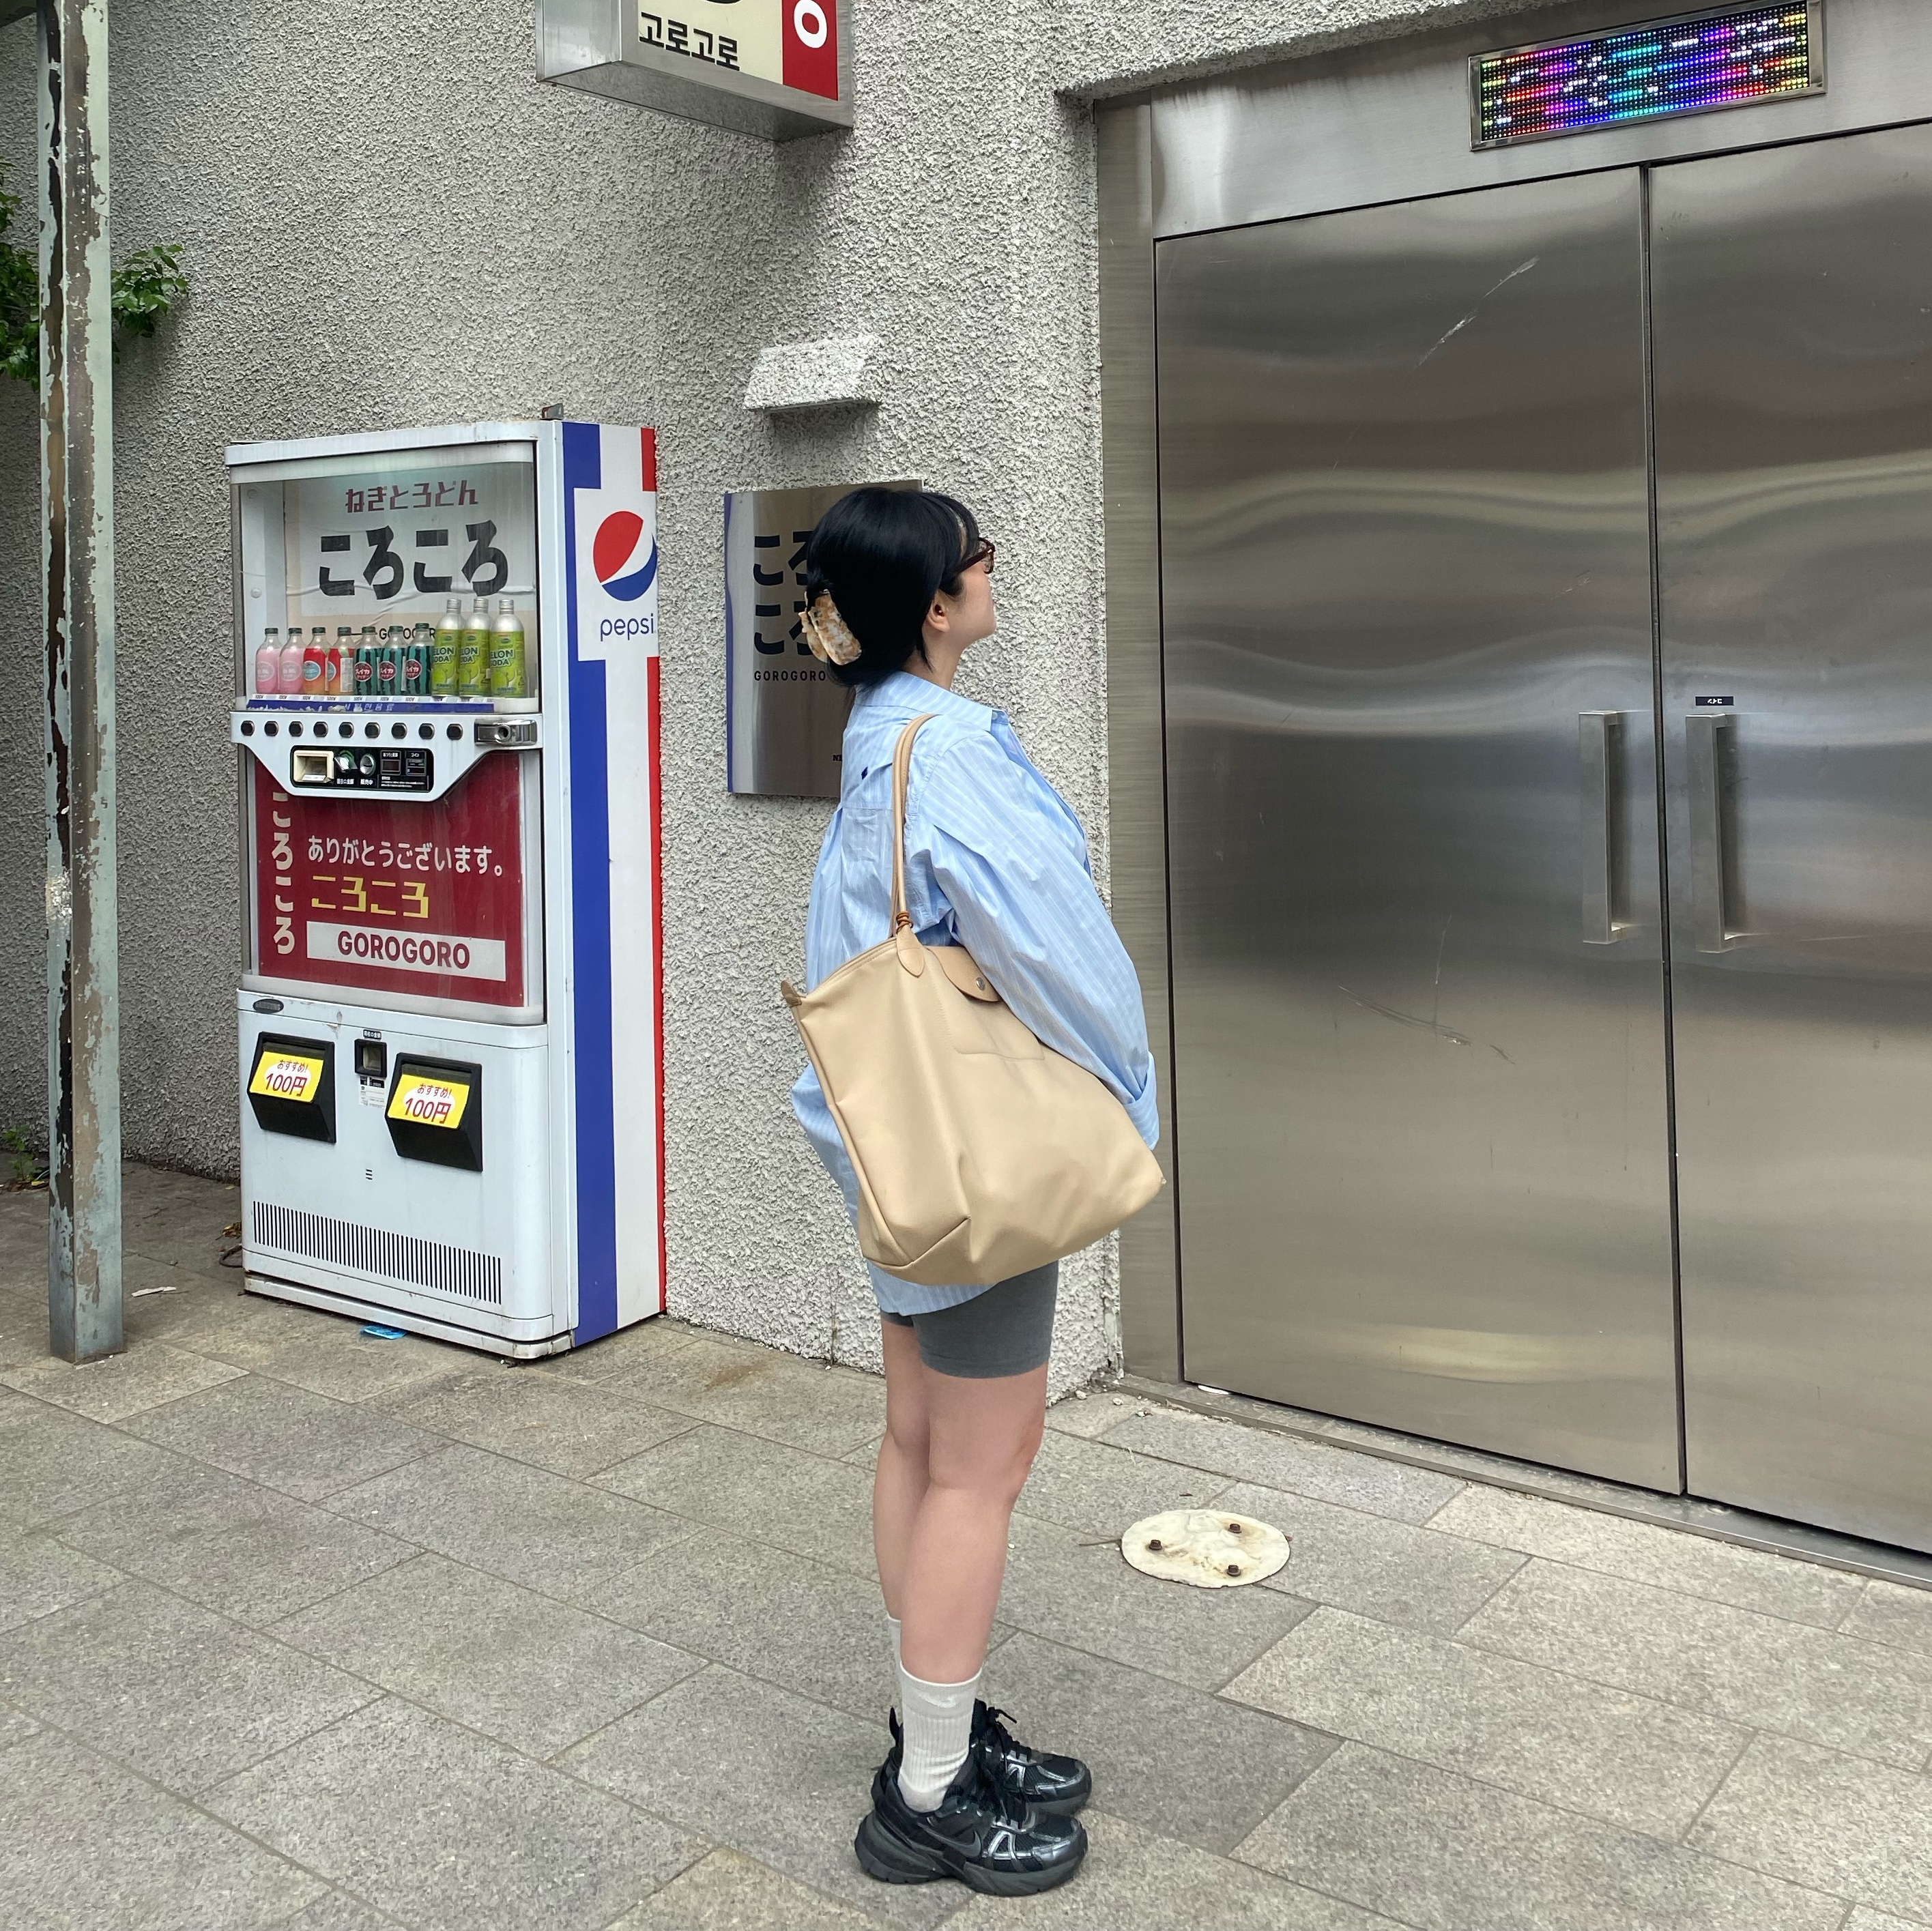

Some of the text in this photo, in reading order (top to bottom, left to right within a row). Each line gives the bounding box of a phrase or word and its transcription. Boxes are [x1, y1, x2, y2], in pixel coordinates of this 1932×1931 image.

[639, 12, 740, 72] 고로고로
[345, 480, 478, 513] ねぎとろどん
[319, 520, 508, 600] ころころ
[600, 613, 654, 641] pepsi
[490, 650, 513, 659] ELON
[754, 670, 827, 682] GOROGORO
[308, 835, 503, 877] ありがとうございます。
[272, 792, 295, 955] ころころ
[311, 875, 429, 918] ころころ
[337, 931, 470, 969] GOROGORO
[277, 1059, 308, 1073] おすすめ!
[265, 1073, 308, 1097] 100円
[418, 1083, 452, 1099] おすすめ!
[405, 1097, 452, 1124] 100円
